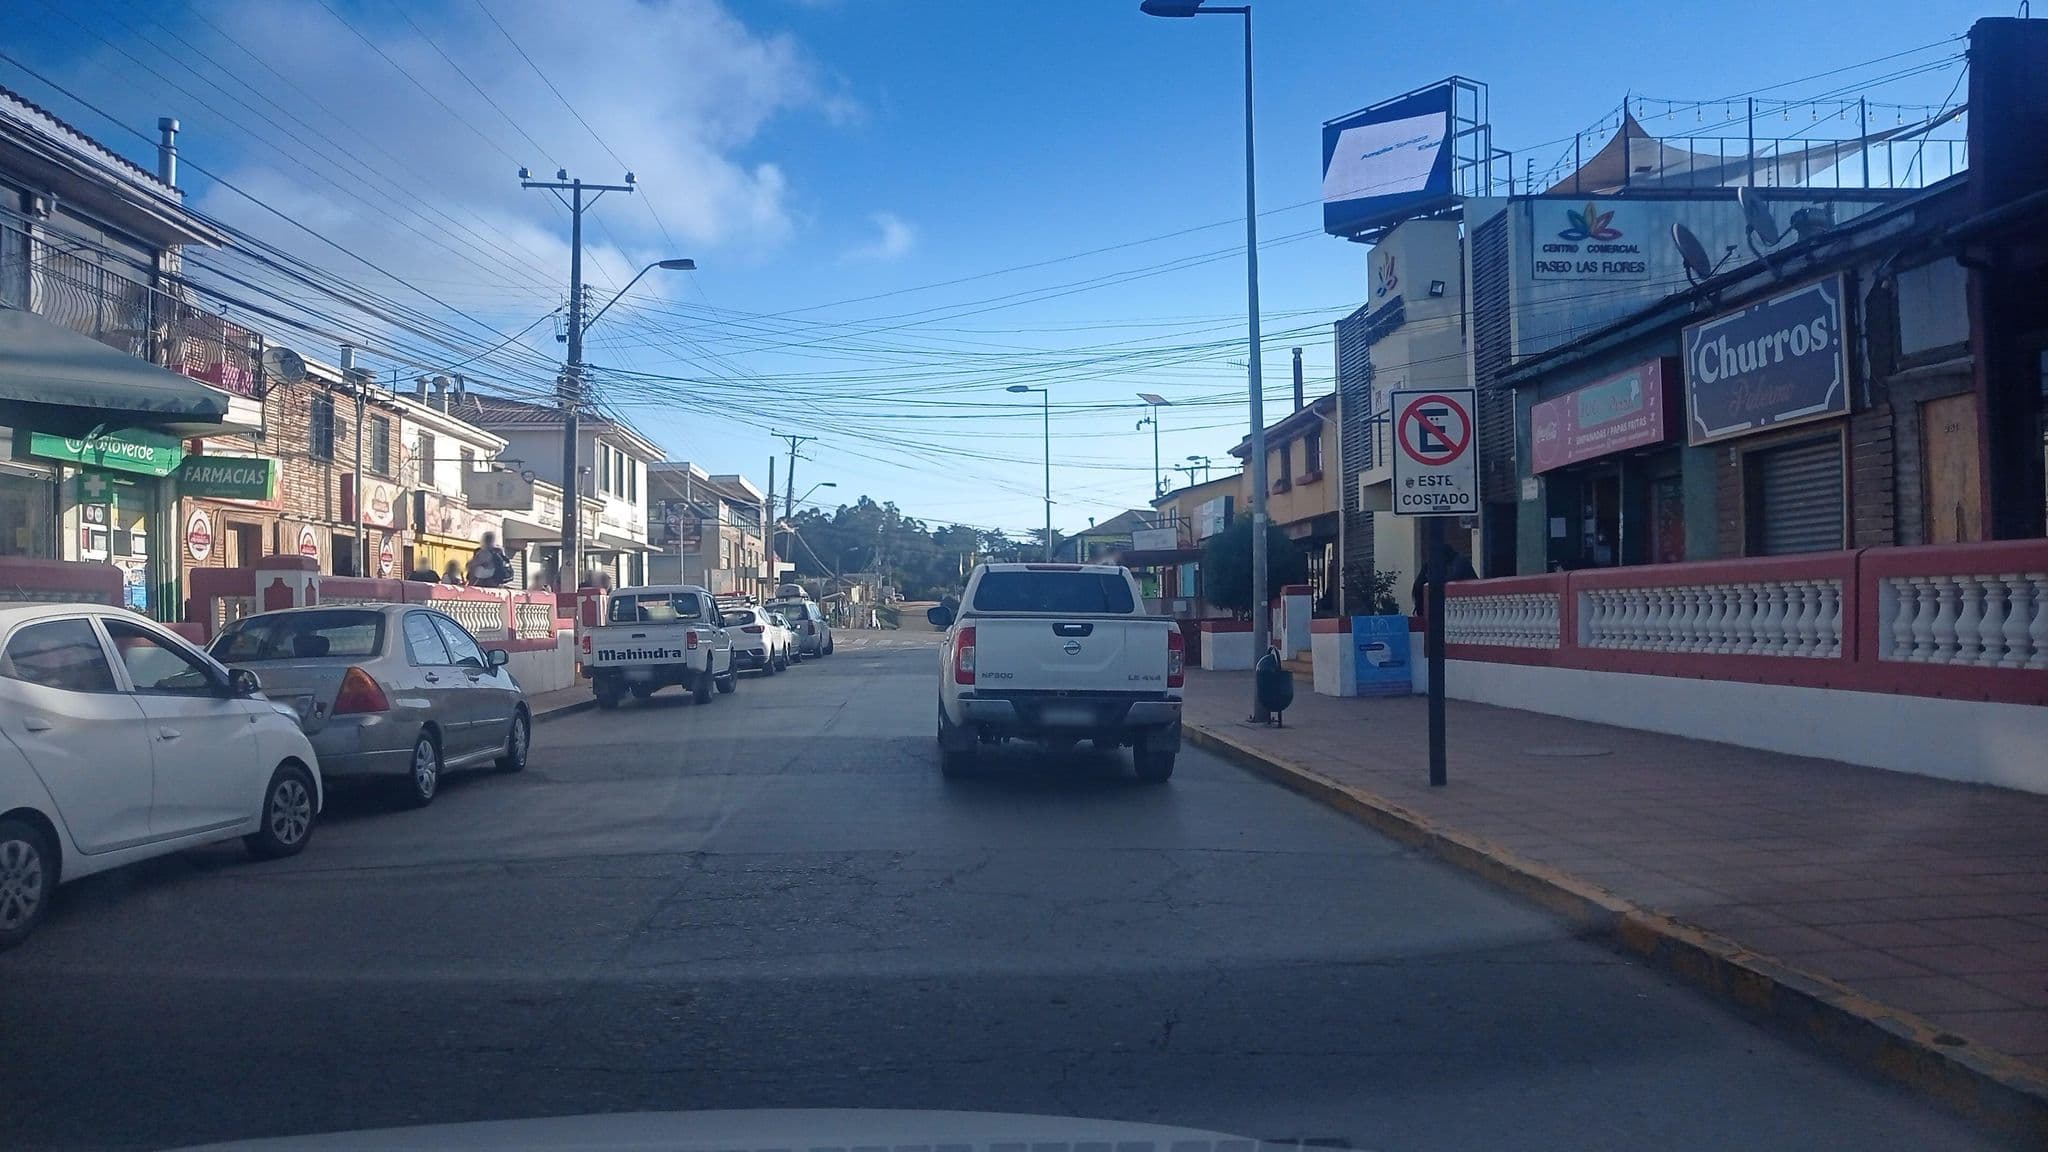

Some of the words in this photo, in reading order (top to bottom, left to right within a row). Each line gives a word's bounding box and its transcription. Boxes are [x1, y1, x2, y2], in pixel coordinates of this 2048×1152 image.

[1542, 244, 1579, 253] CENTRO
[1587, 244, 1640, 253] COMERCIAL
[1536, 260, 1572, 273] PASEO
[1576, 261, 1598, 273] LAS
[1602, 261, 1645, 273] FLORES
[1698, 315, 1828, 384] Churros
[184, 466, 266, 485] FARMACIAS
[1418, 474, 1454, 487] ESTE
[1402, 493, 1470, 506] COSTADO
[598, 648, 682, 661] Mahindra
